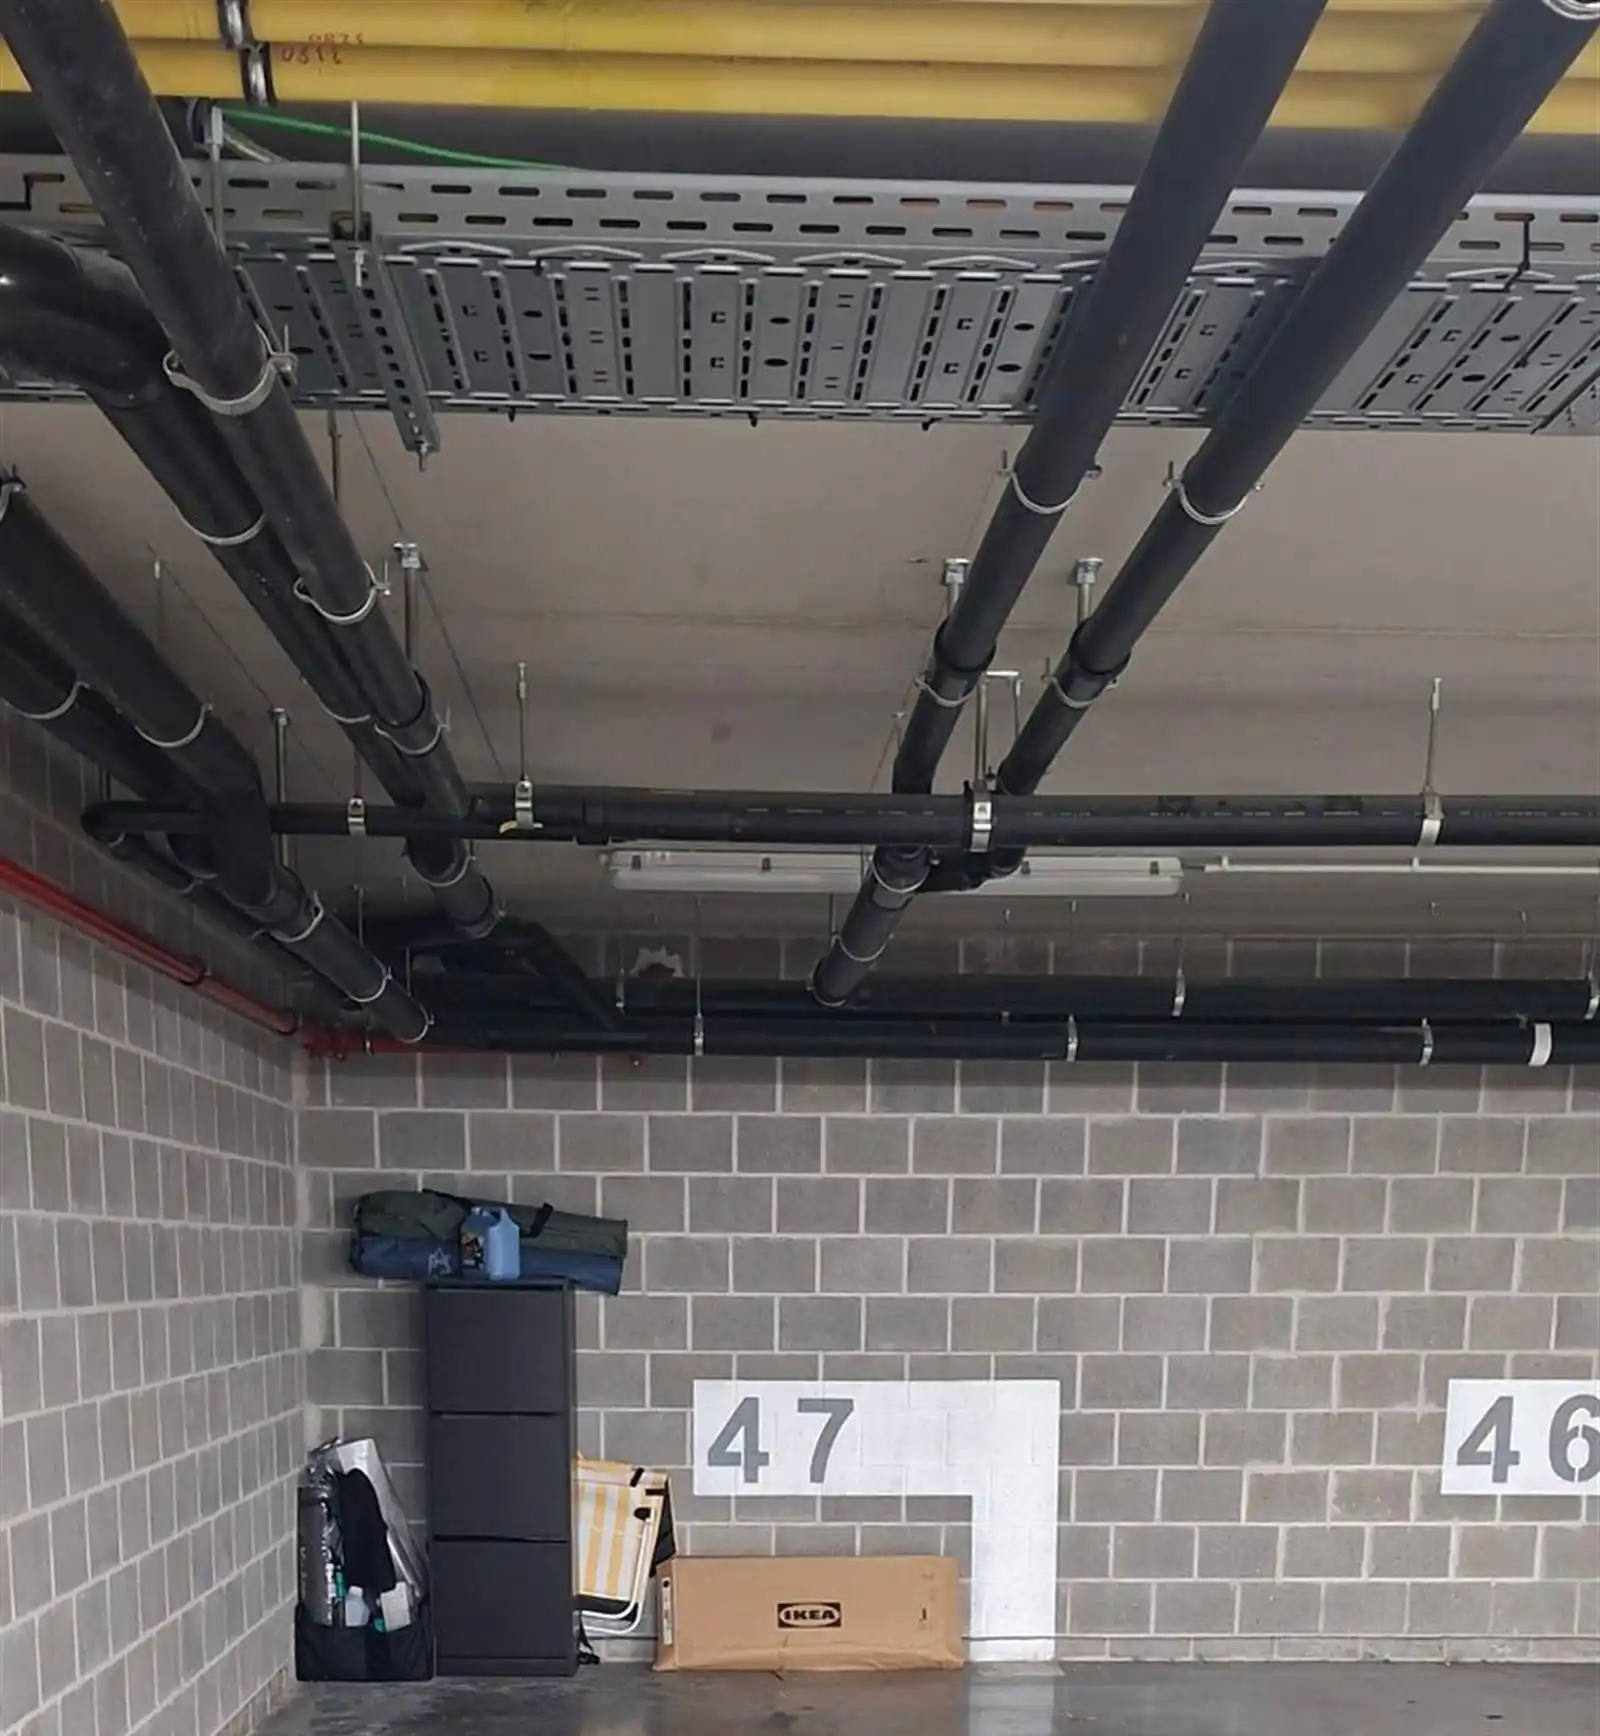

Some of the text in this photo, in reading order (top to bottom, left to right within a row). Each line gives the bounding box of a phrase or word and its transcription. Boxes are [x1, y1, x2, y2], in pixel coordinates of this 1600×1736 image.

[707, 1396, 854, 1484] 47
[1456, 1394, 1600, 1483] 46
[783, 1609, 836, 1621] IKEA
